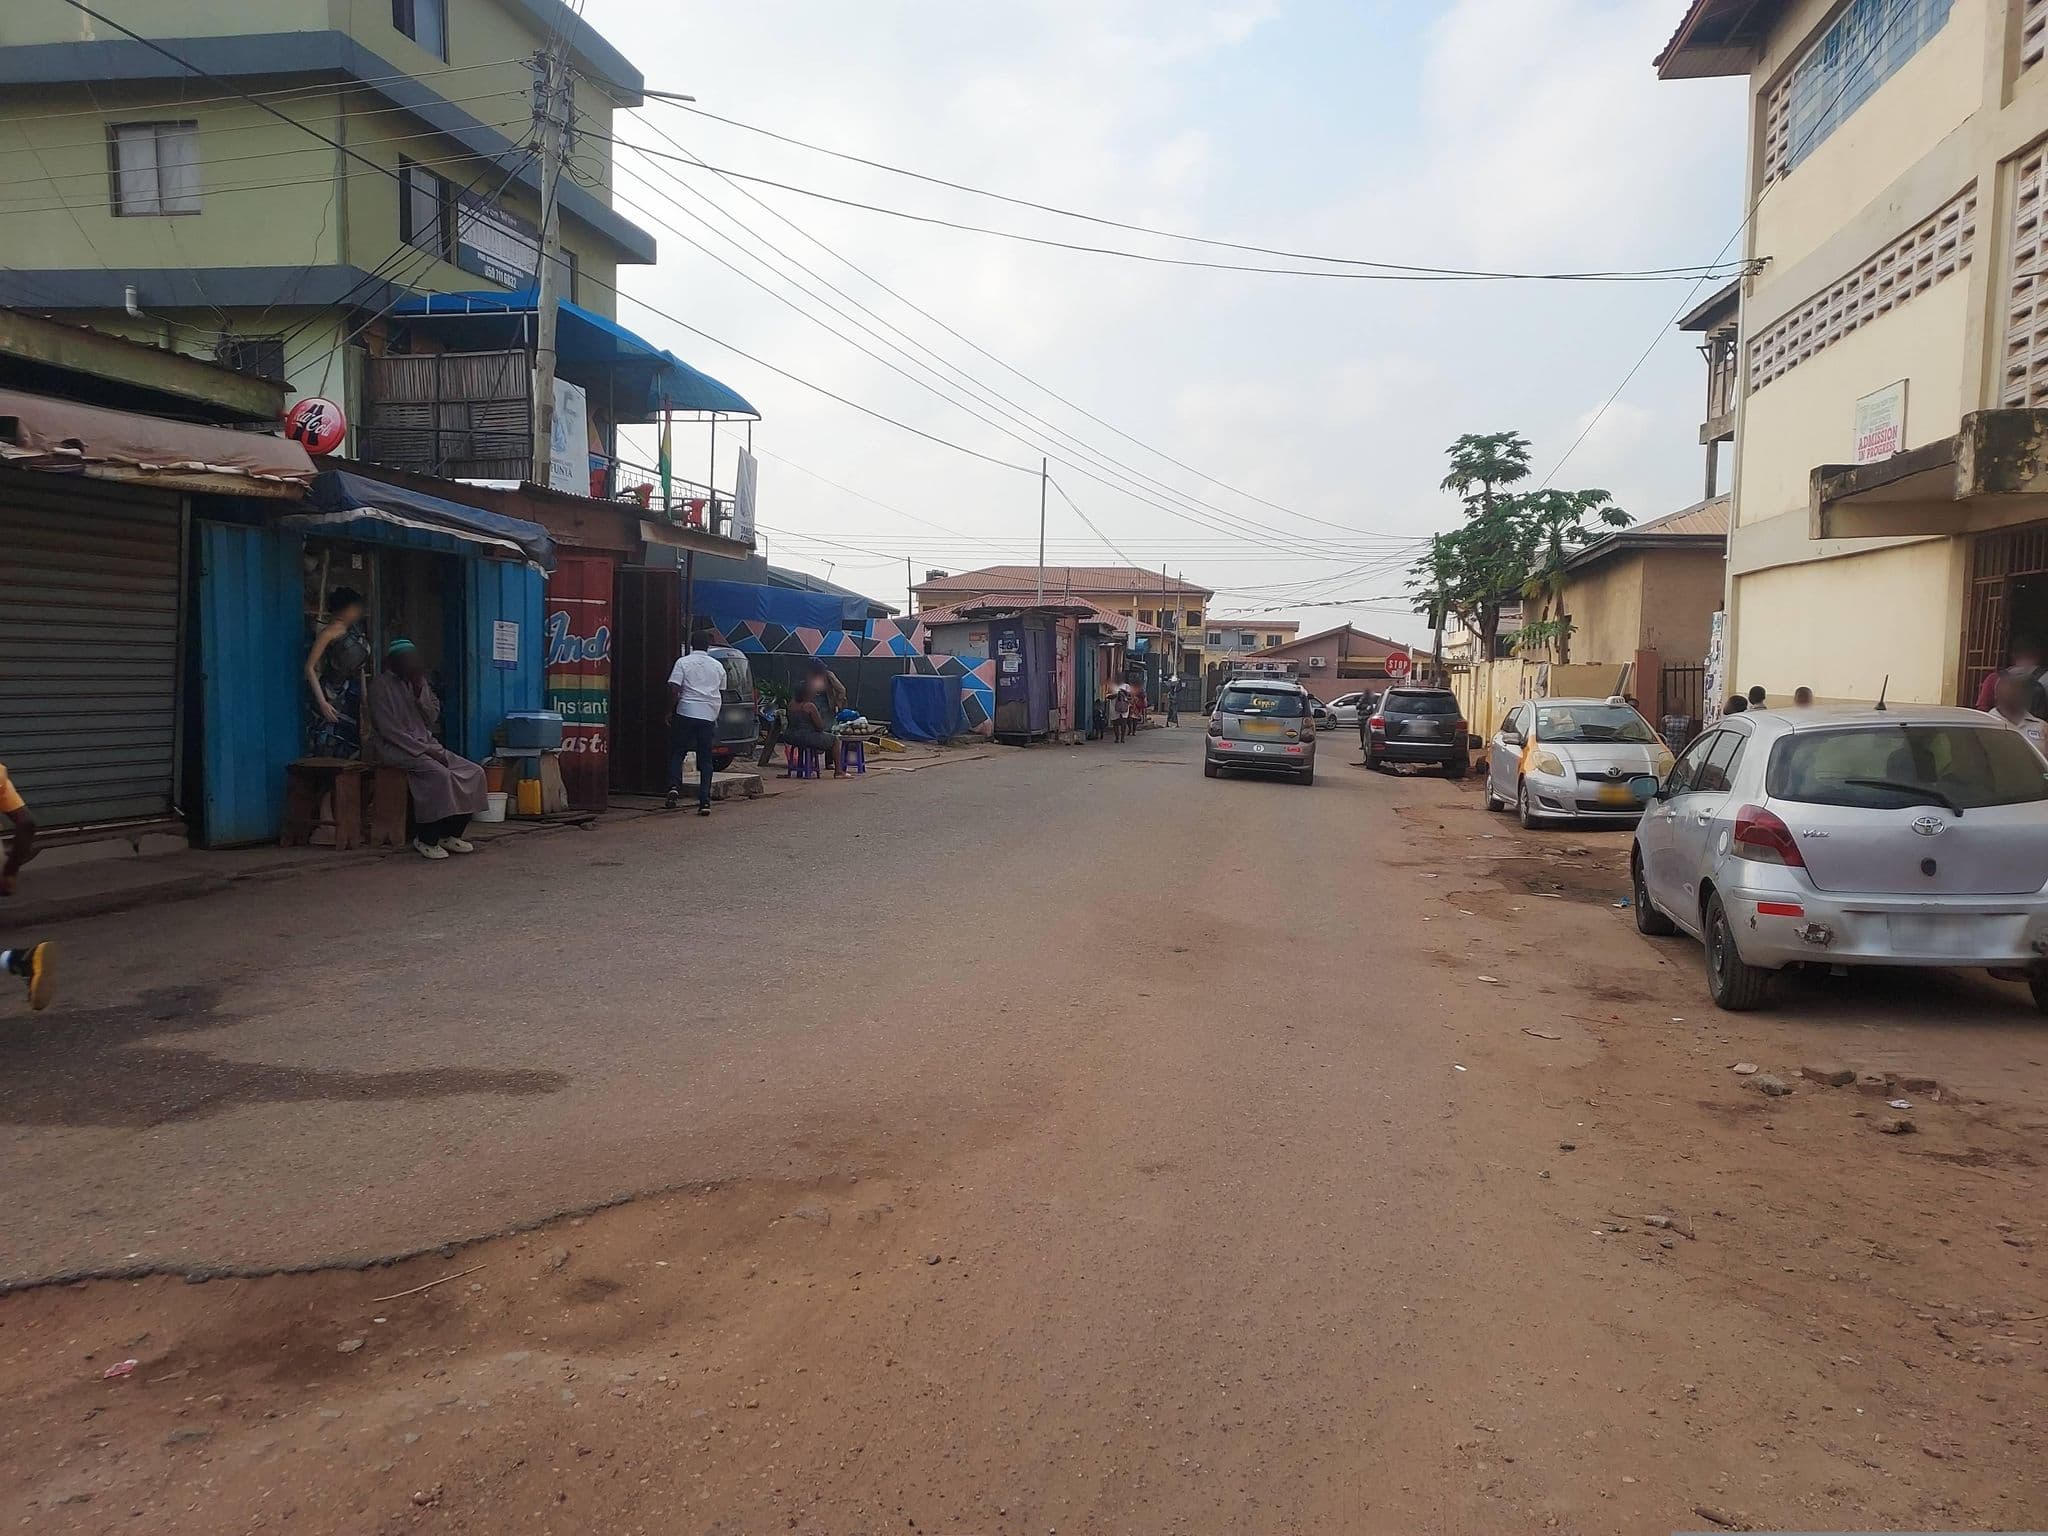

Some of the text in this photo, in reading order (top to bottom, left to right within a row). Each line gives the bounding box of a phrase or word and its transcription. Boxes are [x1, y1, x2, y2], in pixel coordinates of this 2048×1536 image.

[1858, 425, 1898, 450] ADMISSION
[1858, 441, 1896, 461] IN PROGRESS
[1389, 660, 1408, 669] STOP
[553, 696, 608, 714] Instant
